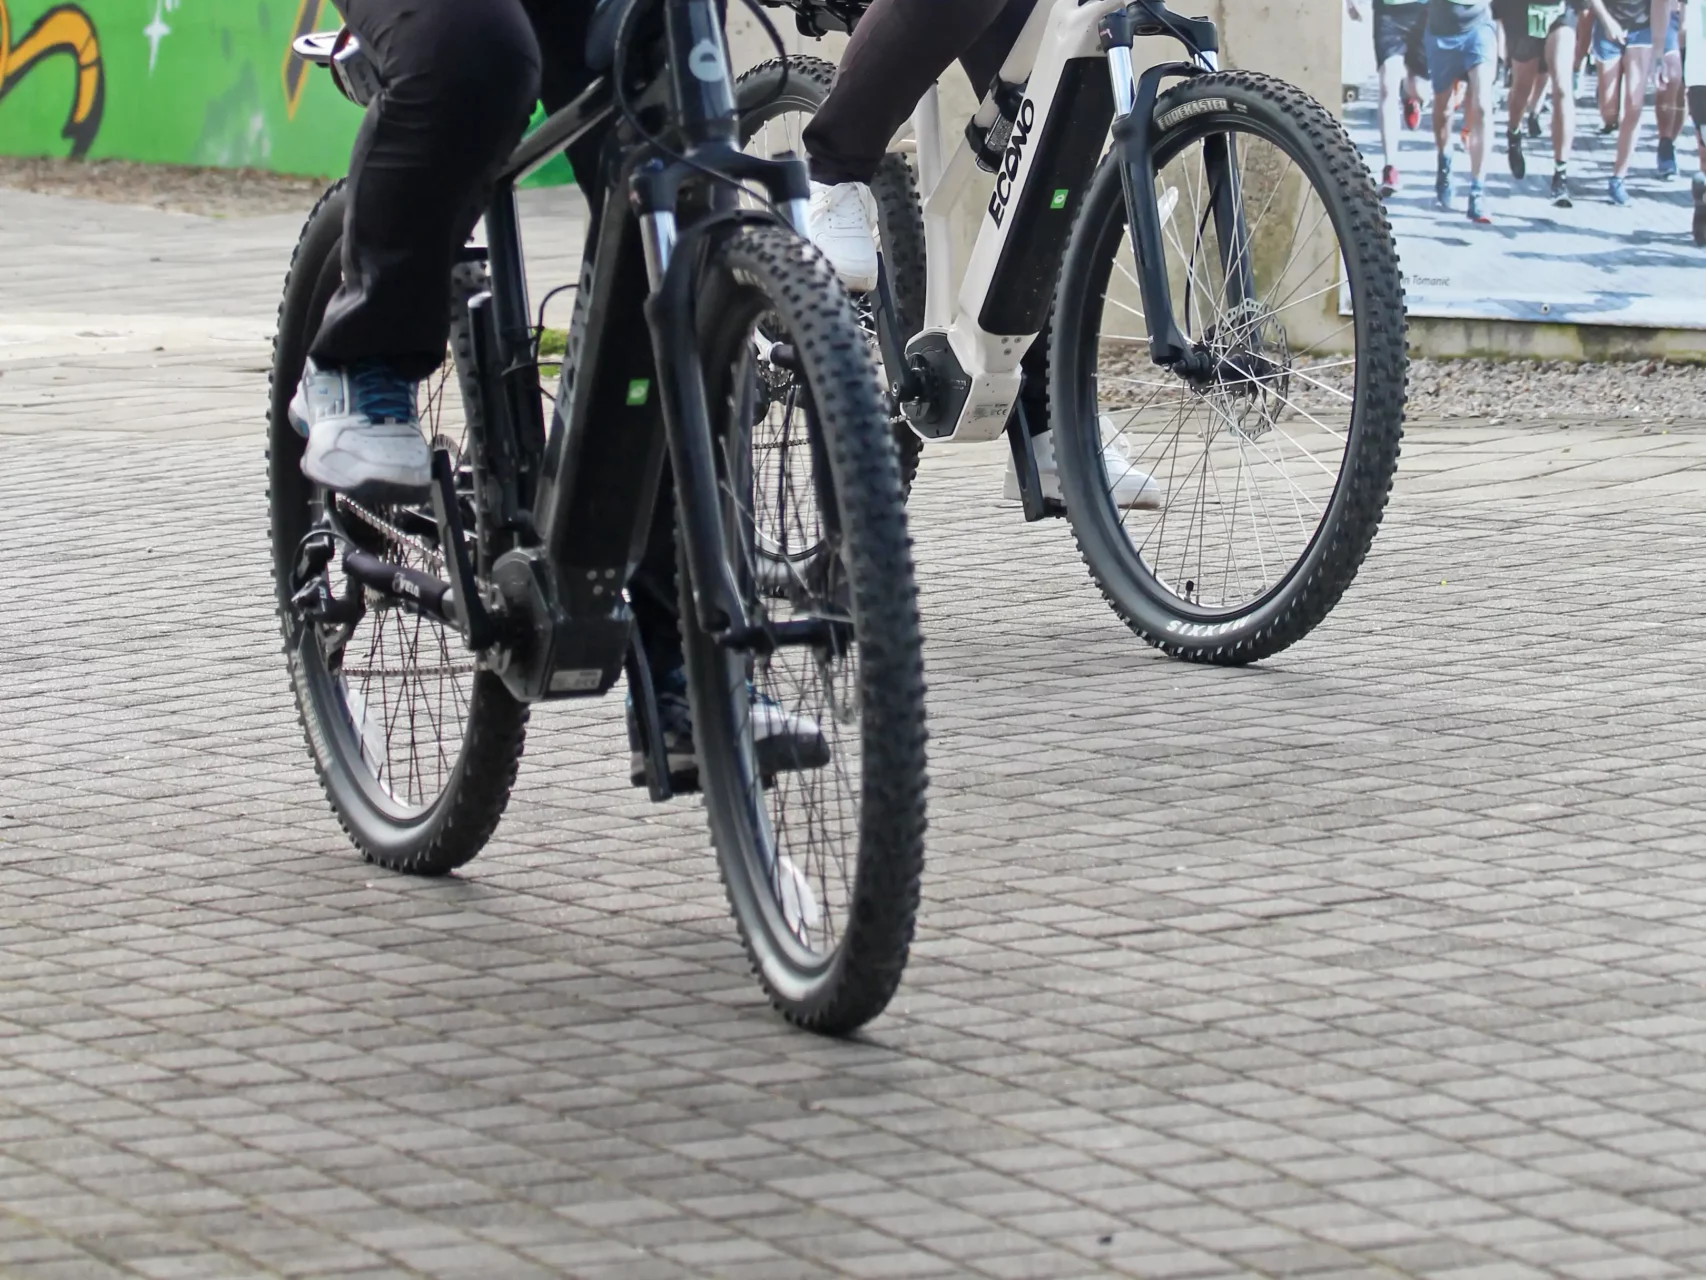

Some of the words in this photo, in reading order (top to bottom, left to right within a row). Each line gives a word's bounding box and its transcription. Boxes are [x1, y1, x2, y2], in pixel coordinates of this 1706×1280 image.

[1157, 98, 1229, 131] FOREKASTER
[988, 99, 1034, 230] ECONO
[1166, 614, 1252, 636] MAXXIS
